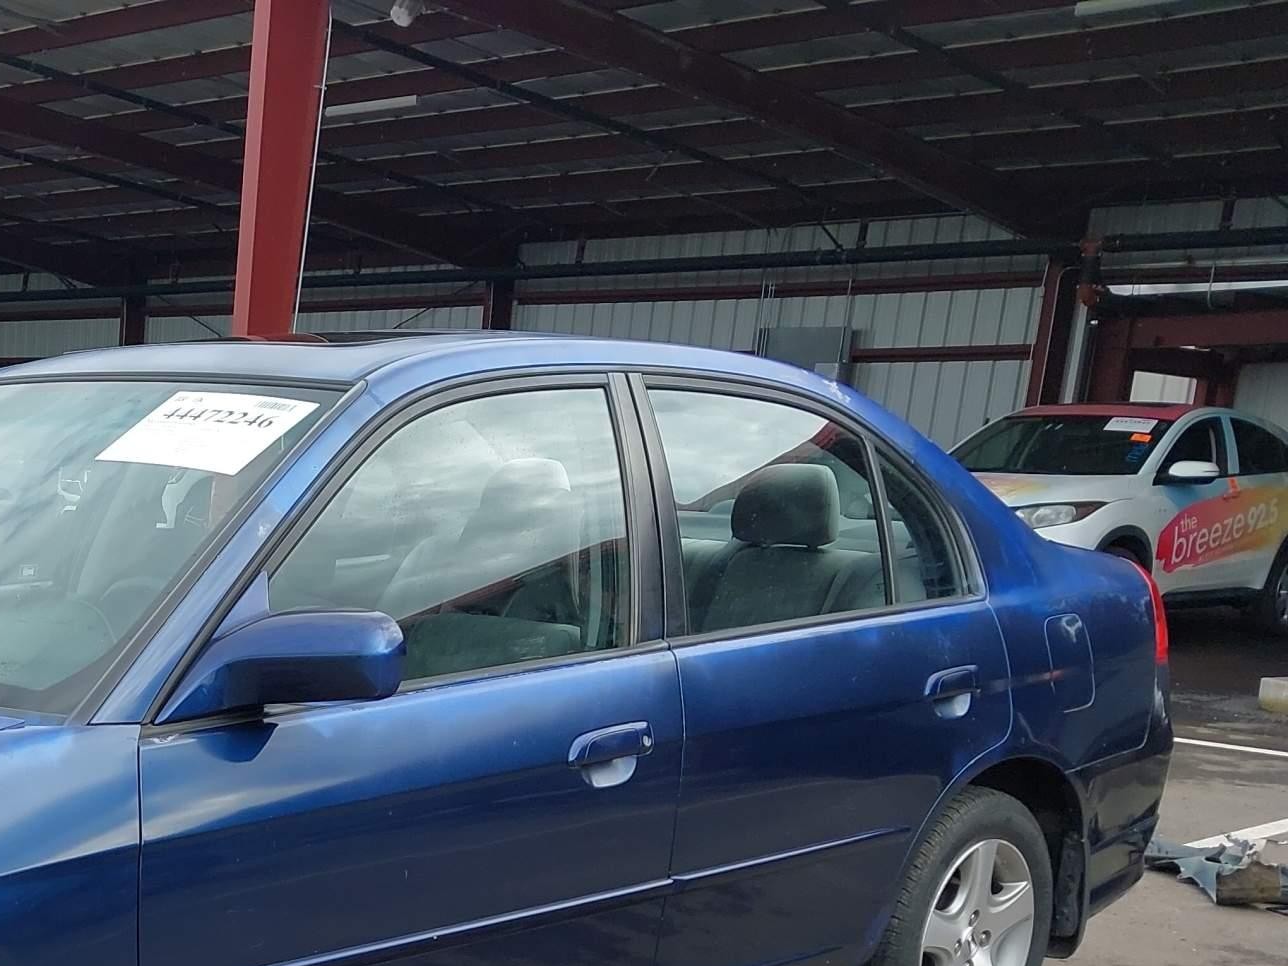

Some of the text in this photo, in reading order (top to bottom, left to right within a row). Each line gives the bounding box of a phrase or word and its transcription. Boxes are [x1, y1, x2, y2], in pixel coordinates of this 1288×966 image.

[163, 407, 280, 428] 44472246
[1180, 513, 1198, 533] the
[1171, 512, 1245, 565] breeze
